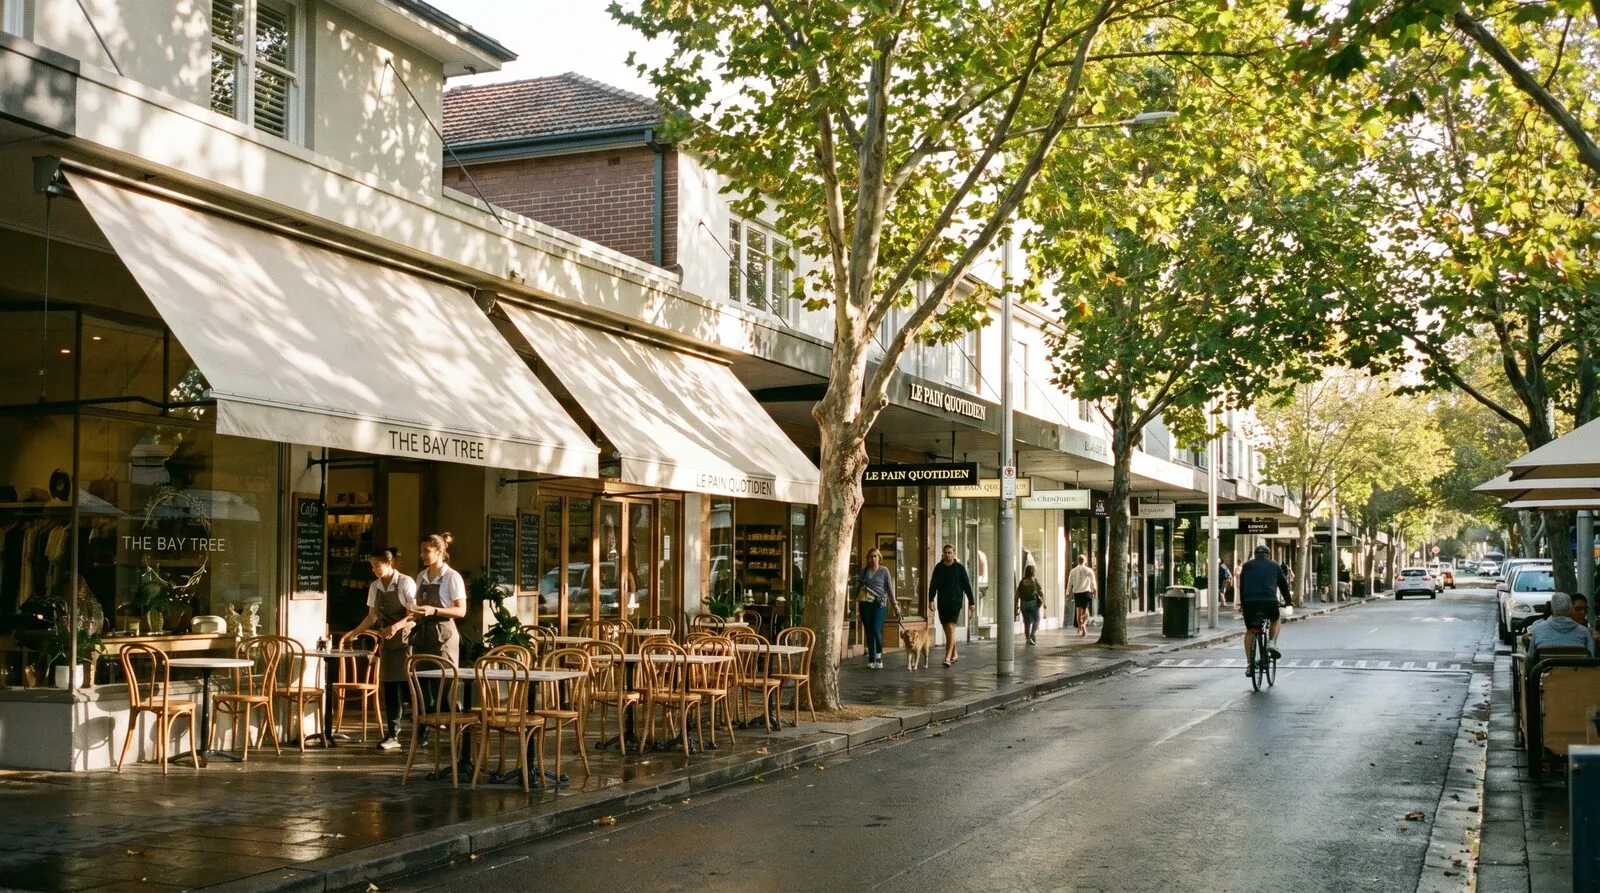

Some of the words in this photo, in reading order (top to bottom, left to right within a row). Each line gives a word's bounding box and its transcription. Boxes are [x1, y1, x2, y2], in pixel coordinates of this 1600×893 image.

[911, 383, 922, 402] LE
[924, 388, 944, 408] PAIN
[944, 394, 986, 420] QUOTIDIEN
[389, 430, 418, 452] THE
[423, 435, 448, 456] BAY
[452, 439, 484, 460] TREE
[696, 474, 706, 488] LE
[728, 478, 772, 496] QUOTIDIEN
[866, 472, 879, 480] LE
[882, 471, 906, 480] PAIN
[908, 470, 970, 481] QUOTIDIEN
[122, 536, 152, 550] THE
[157, 537, 186, 552] BAY
[190, 538, 226, 552] TREE
